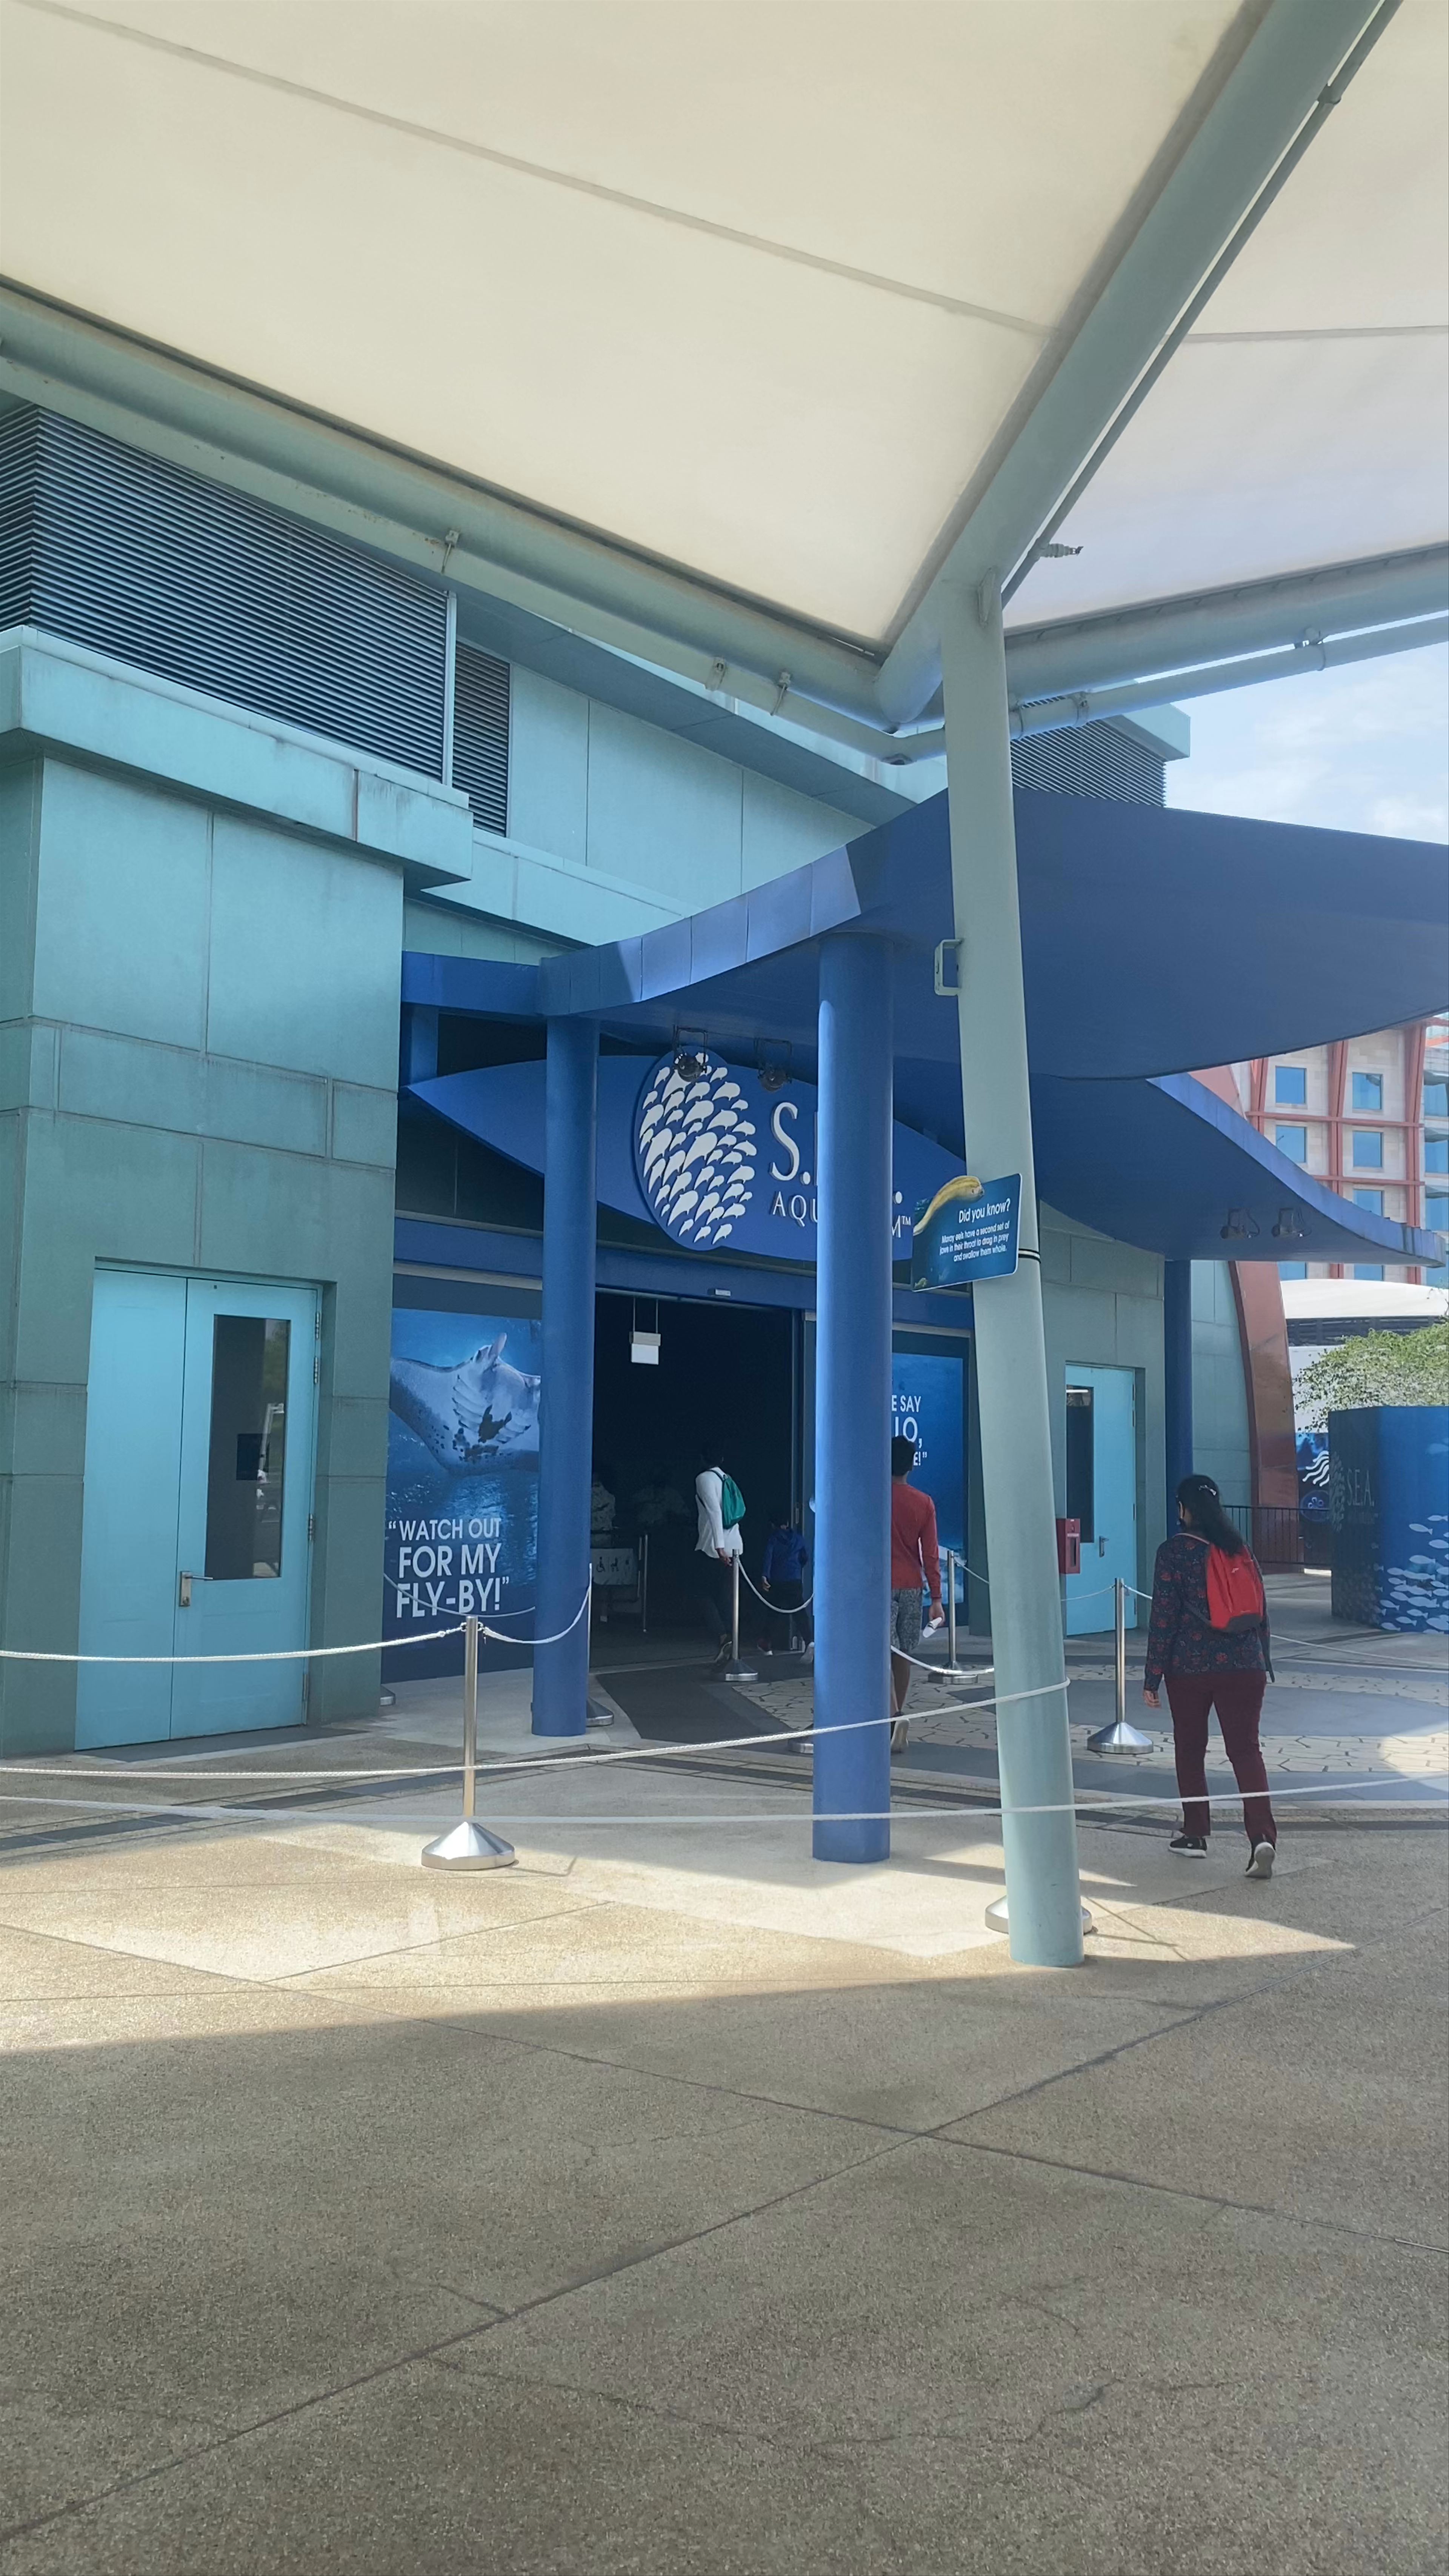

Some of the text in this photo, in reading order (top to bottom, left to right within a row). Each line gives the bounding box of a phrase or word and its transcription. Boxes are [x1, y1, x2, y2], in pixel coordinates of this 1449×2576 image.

[959, 1198, 1011, 1223] Did you know?
[964, 1229, 975, 1238] have
[980, 1224, 997, 1235] second
[1004, 1221, 1010, 1229] of
[954, 1242, 963, 1251] their
[982, 1236, 993, 1246] drag
[993, 1234, 998, 1243] in
[998, 1233, 1009, 1244] prey
[954, 1252, 963, 1262] and
[963, 1250, 980, 1260] swallow
[980, 1248, 992, 1256] them
[900, 1395, 921, 1412] SAY
[469, 1518, 502, 1538] OUT
[399, 1543, 502, 1578] FOR MY
[397, 1576, 509, 1618] FLY-BY!”
